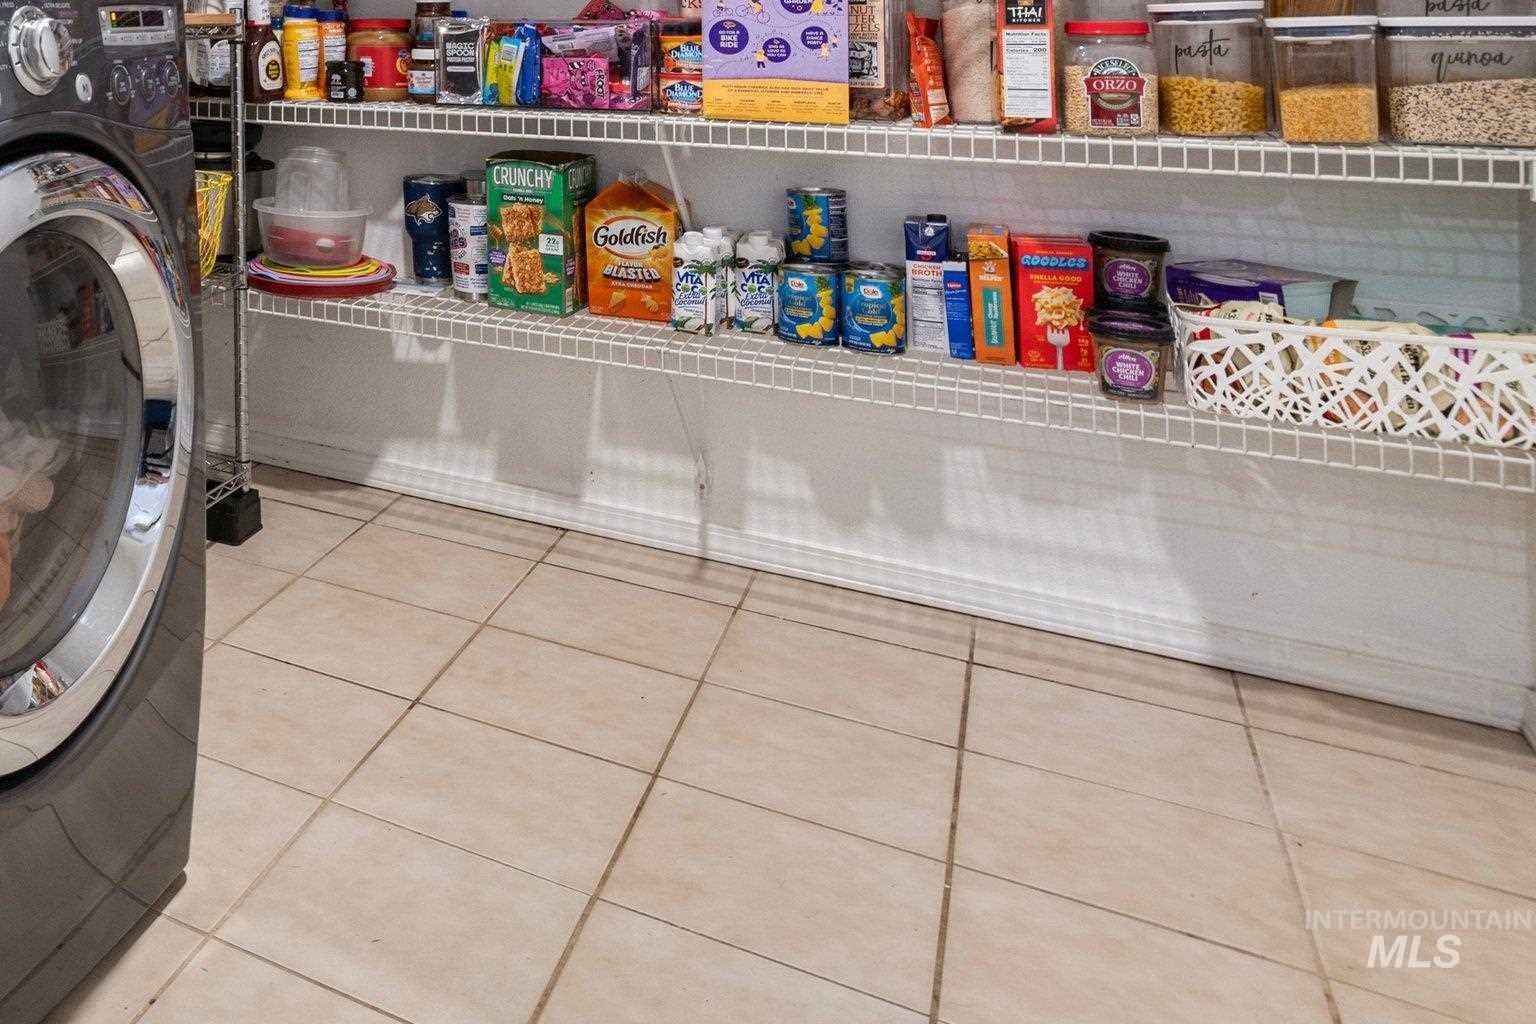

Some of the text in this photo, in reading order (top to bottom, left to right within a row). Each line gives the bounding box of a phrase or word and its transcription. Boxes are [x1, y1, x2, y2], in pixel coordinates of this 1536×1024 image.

[1007, 6, 1043, 19] THAI
[720, 34, 739, 42] BIKE
[445, 42, 474, 50] MAGIC
[680, 44, 702, 52] BLUE
[720, 41, 739, 49] RIDE
[445, 49, 475, 57] SPOON
[1175, 28, 1233, 73] pasta
[1430, 46, 1514, 85] quinoa
[595, 69, 605, 99] FROOT
[674, 84, 694, 92] BLUE
[1092, 80, 1137, 91] ORZO
[666, 90, 702, 98] DIAMOND
[493, 165, 554, 189] CRUNCHY
[503, 194, 516, 202] Oats
[524, 195, 544, 204] Honey
[592, 225, 669, 248] Goldfish
[1021, 255, 1089, 270] GOODLES
[602, 267, 662, 281] BLASTED
[911, 268, 943, 277] BROTH
[1116, 270, 1140, 278] WHITE
[677, 271, 703, 285] VITA
[742, 271, 769, 285] VITA
[1112, 275, 1143, 285] CHICKEN
[790, 279, 807, 289] Dole
[1118, 281, 1137, 289] CHILI
[675, 284, 707, 296] COCO
[740, 284, 773, 296] COCO
[863, 288, 879, 296] Dole
[679, 291, 701, 301] Extra
[744, 291, 768, 301] Extra
[674, 298, 705, 307] Coconut
[740, 298, 772, 307] Coconut
[1115, 361, 1140, 370] WHITE
[1112, 366, 1145, 377] CHICKEN
[1118, 373, 1139, 382] CHILI
